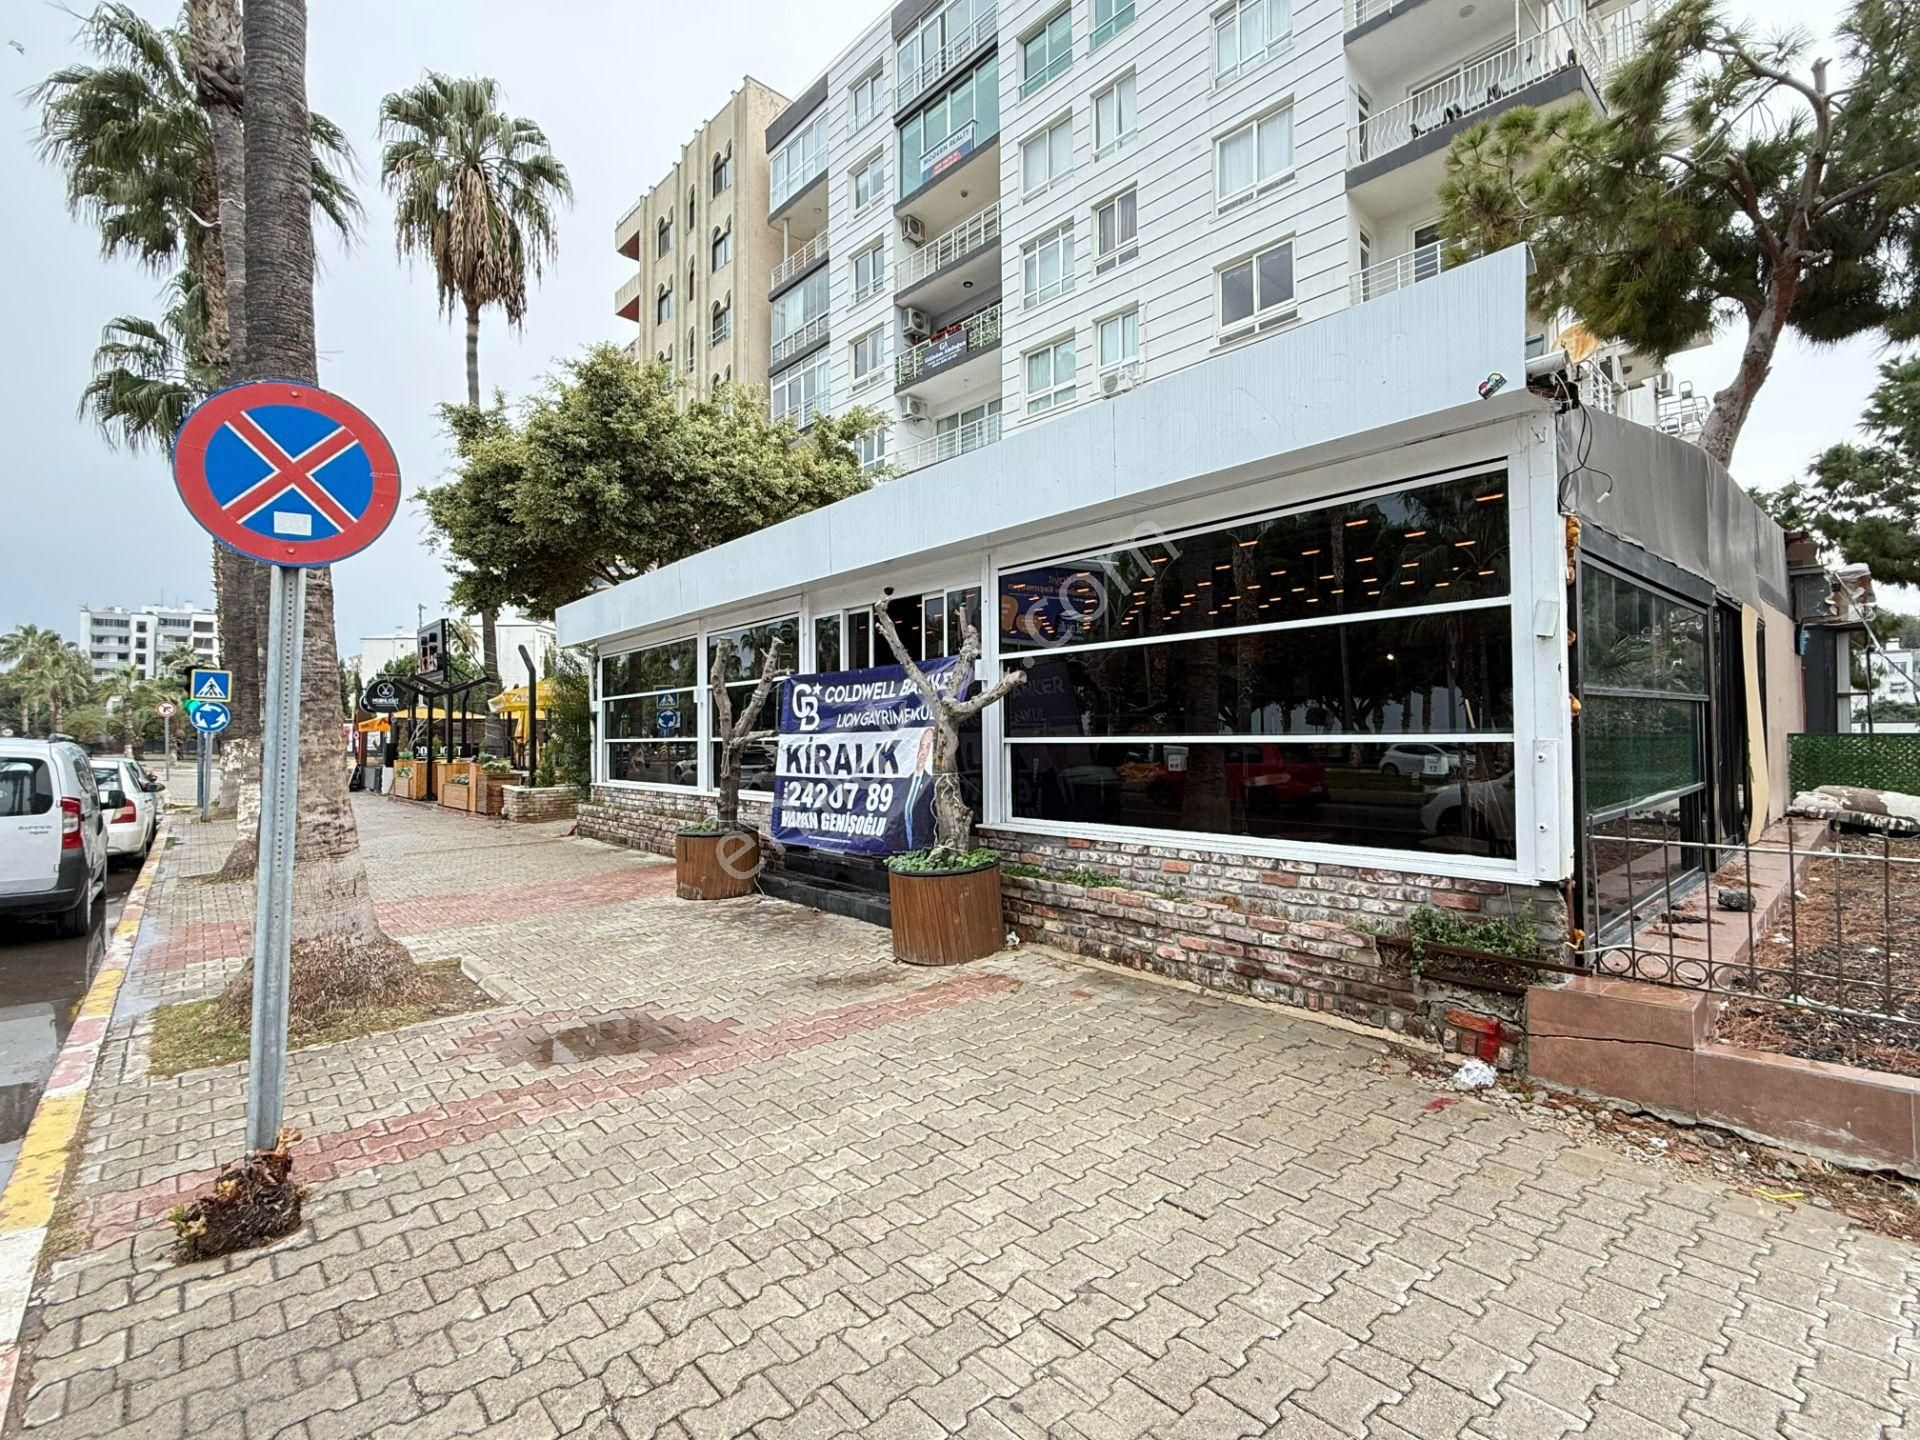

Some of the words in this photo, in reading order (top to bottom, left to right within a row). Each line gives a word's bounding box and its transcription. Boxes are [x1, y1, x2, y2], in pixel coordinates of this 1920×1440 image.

[824, 680, 896, 704] COLDWELL
[899, 671, 953, 697] BAKE
[1011, 675, 1065, 698] ANKER
[836, 712, 861, 728] LION
[785, 735, 902, 776] KİRALIK
[865, 783, 894, 812] 89
[820, 811, 887, 837] GENİŞOĞLU
